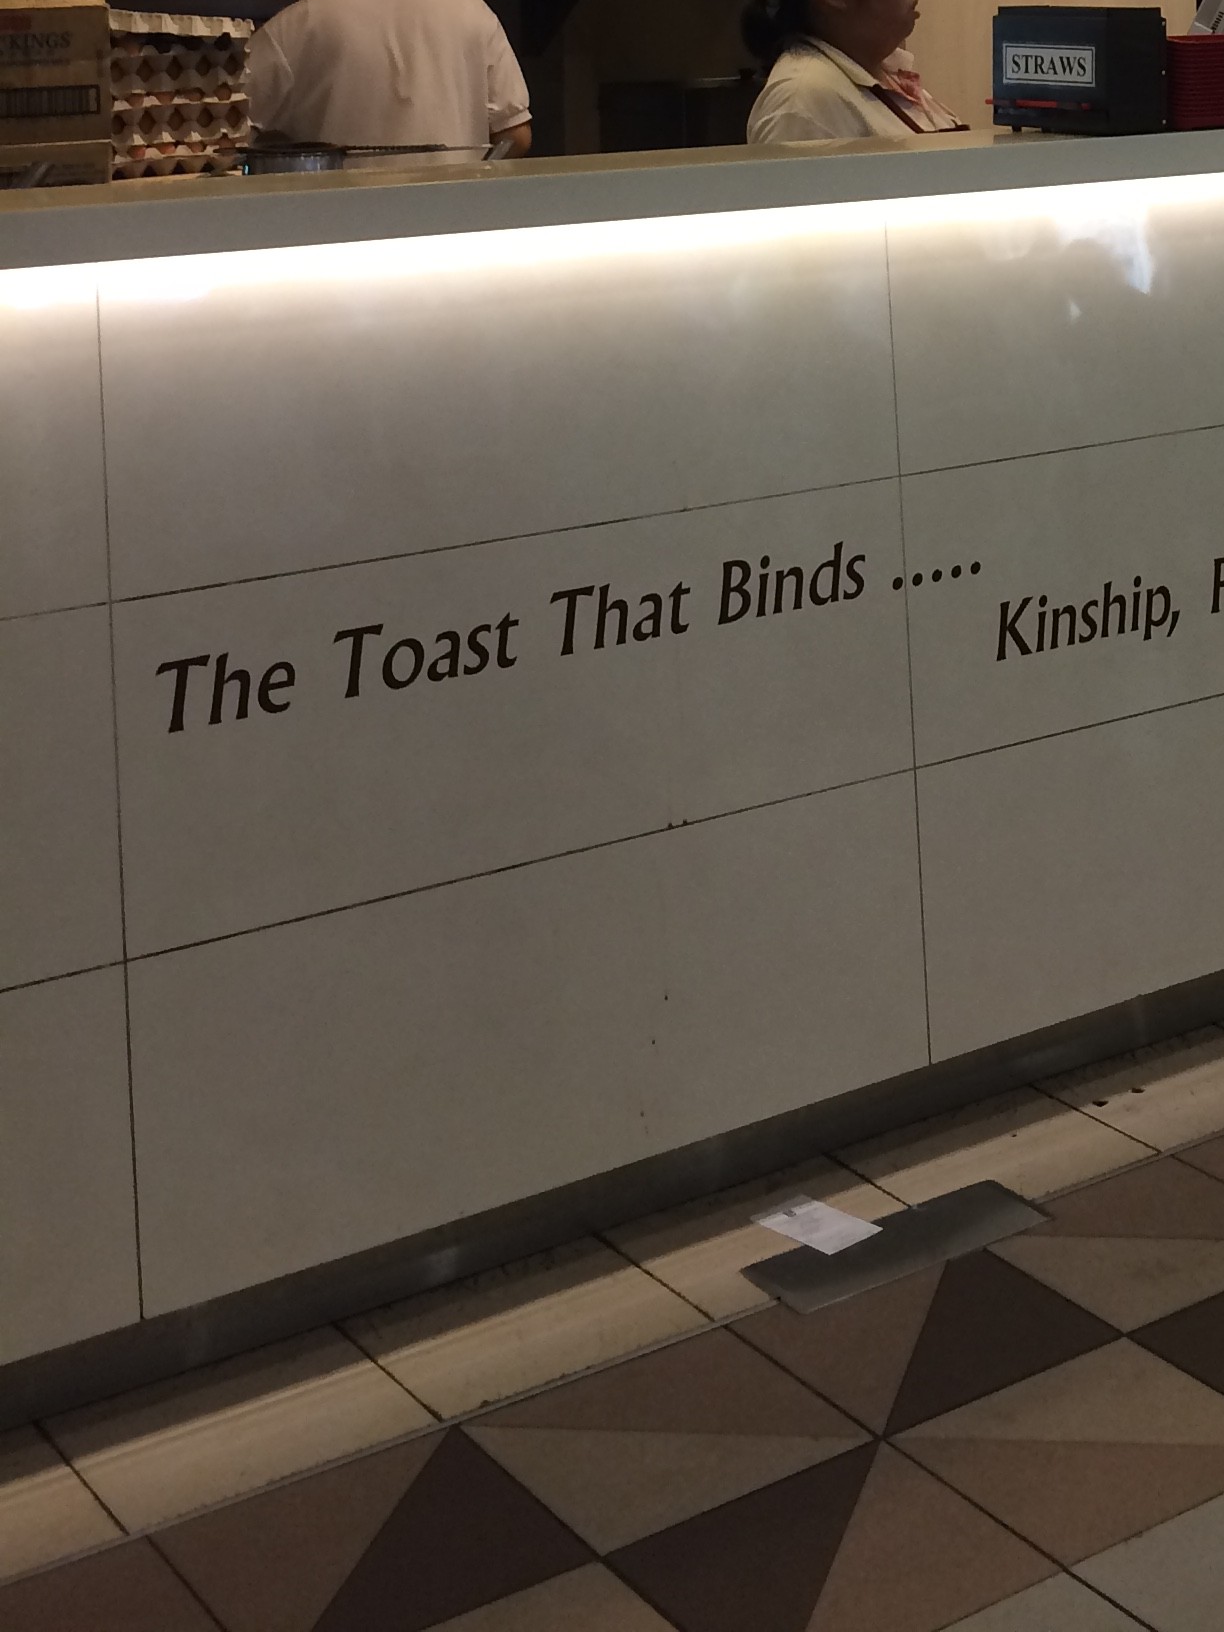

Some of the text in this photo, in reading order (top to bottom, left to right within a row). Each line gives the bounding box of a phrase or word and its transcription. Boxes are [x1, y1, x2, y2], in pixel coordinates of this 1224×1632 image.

[1011, 54, 1087, 78] STRAWS
[154, 651, 296, 734] The
[333, 611, 519, 699] Toast
[549, 579, 692, 657] That
[716, 541, 866, 626] Binds
[996, 576, 1181, 662] Kinship,
